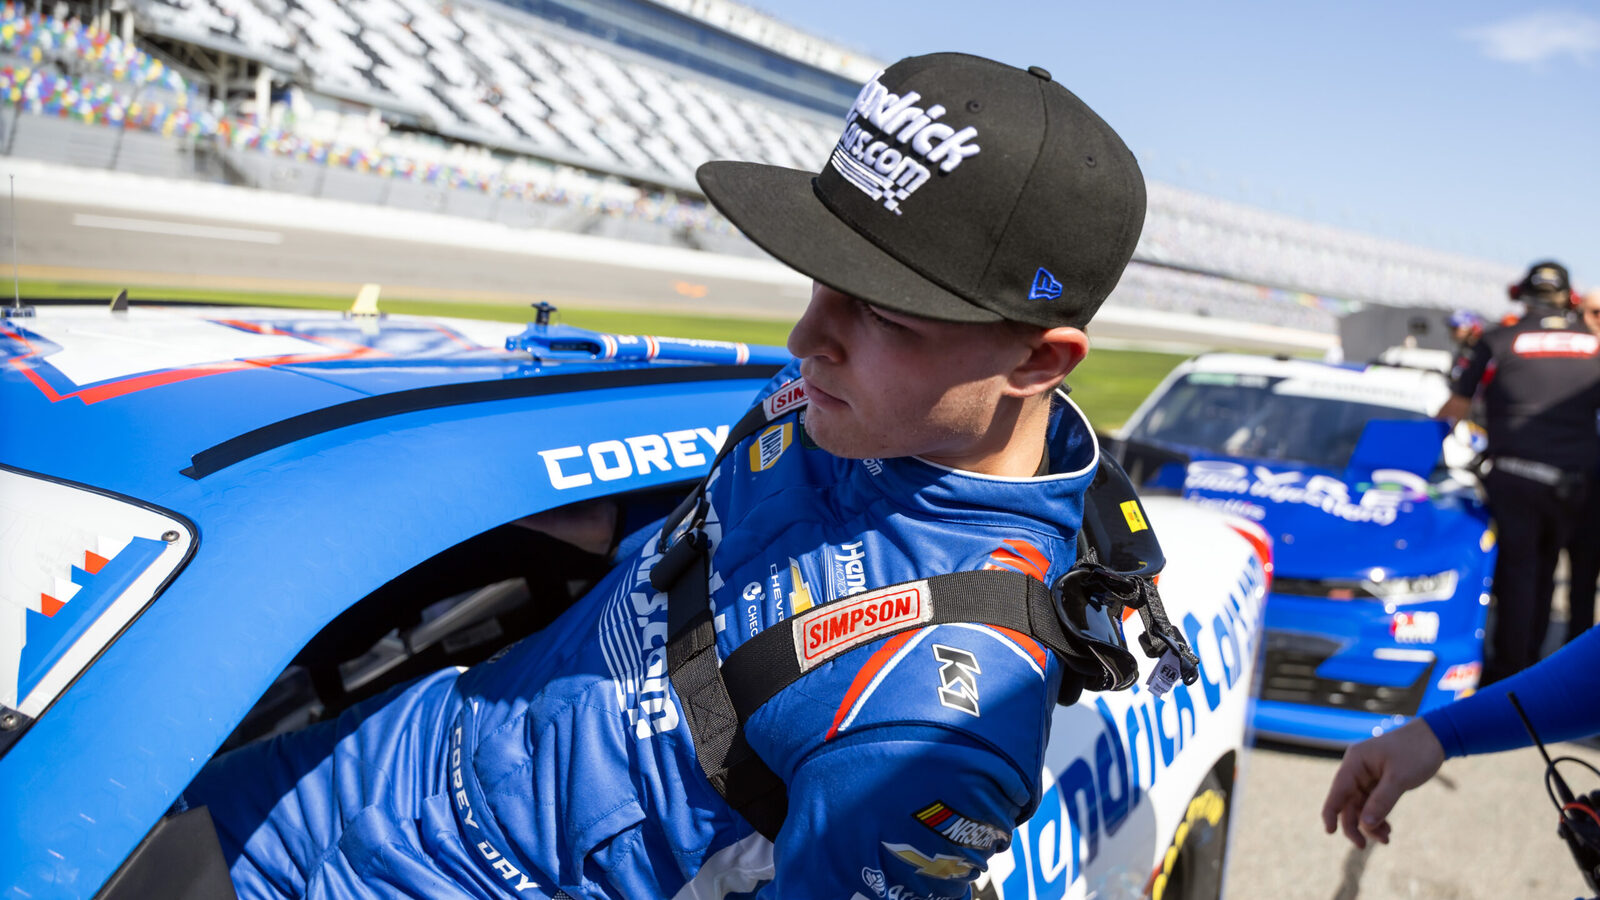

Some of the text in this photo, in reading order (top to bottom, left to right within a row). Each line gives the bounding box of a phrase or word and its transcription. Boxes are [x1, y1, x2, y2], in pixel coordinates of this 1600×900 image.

[537, 425, 729, 490] COREY
[761, 427, 782, 469] NAPA
[770, 563, 785, 622] CHEVR
[747, 605, 759, 638] CHEC
[809, 596, 911, 649] SIMPSON
[1160, 665, 1177, 680] FIA
[453, 726, 541, 892] COREY DAY
